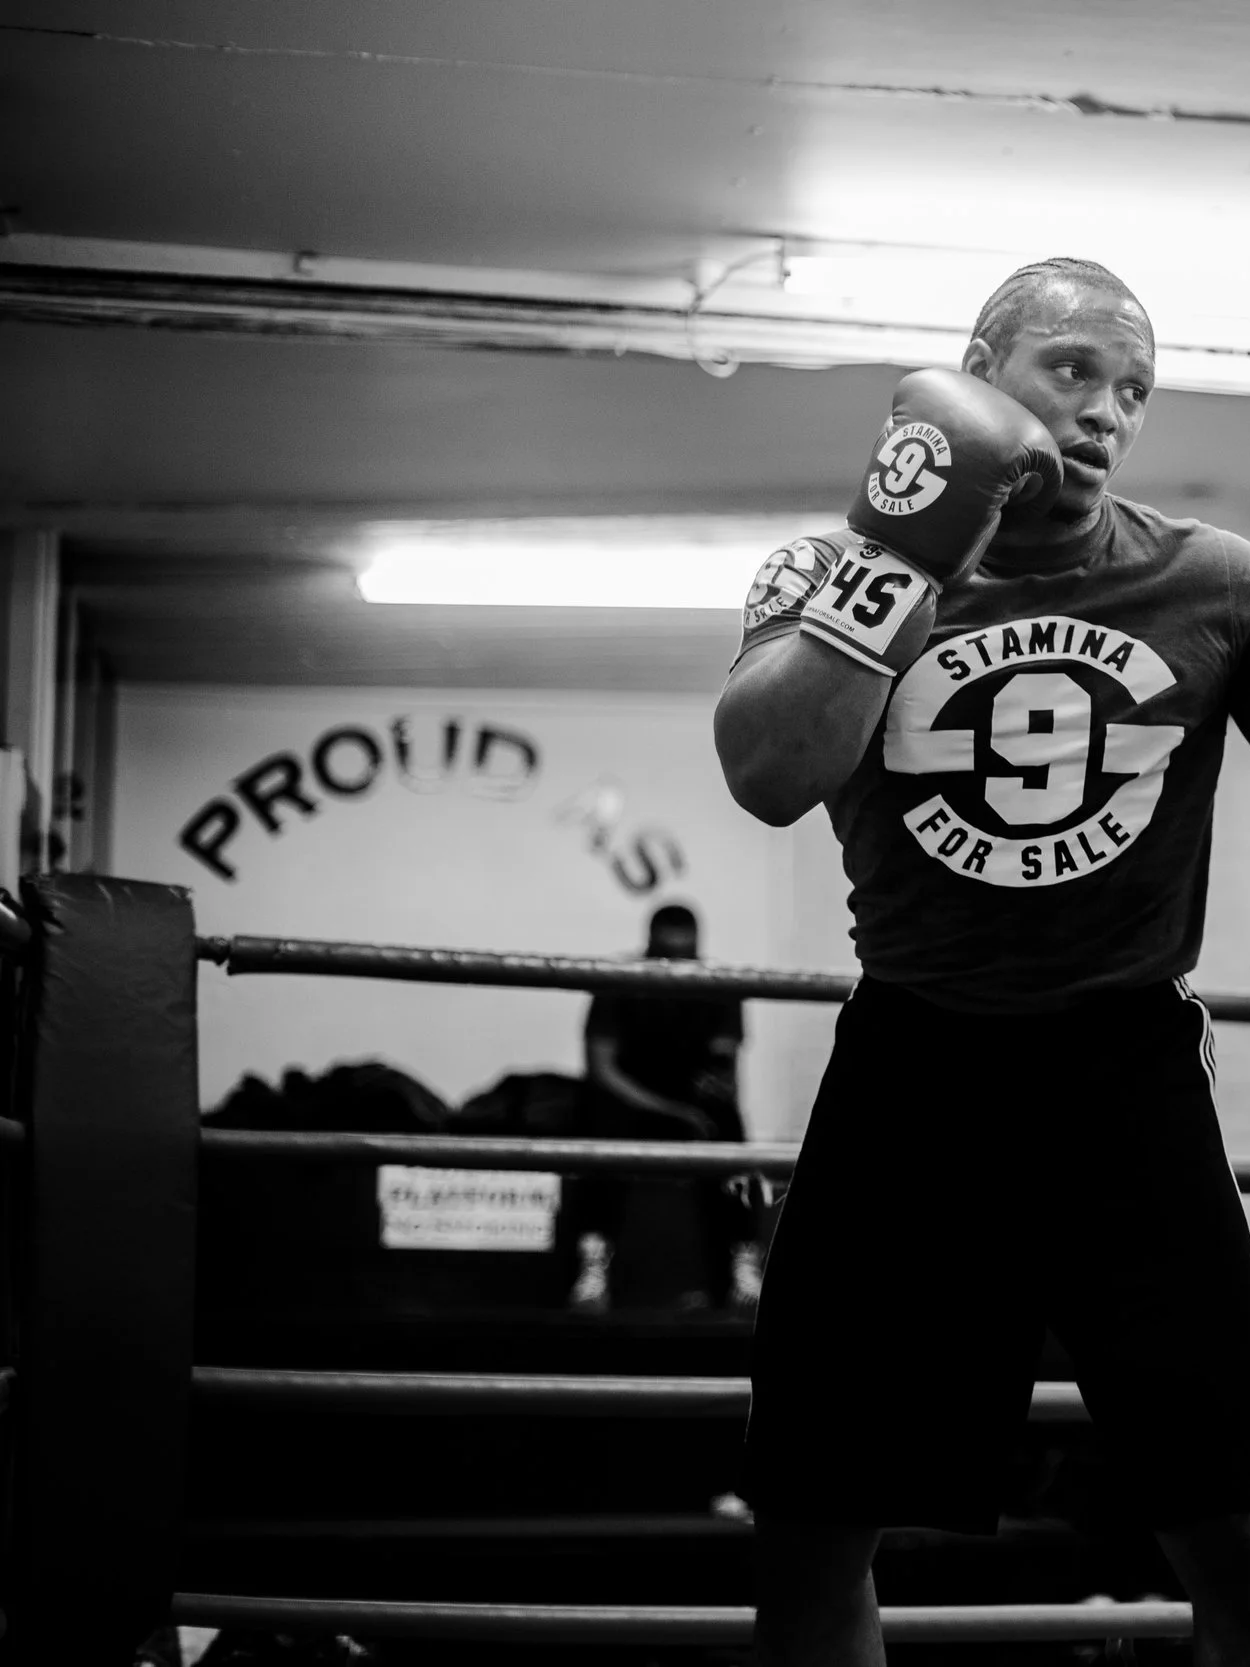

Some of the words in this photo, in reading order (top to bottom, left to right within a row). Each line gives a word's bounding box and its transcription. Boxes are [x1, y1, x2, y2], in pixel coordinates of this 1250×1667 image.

[902, 424, 948, 456] STAMINA
[869, 476, 880, 502] FOR
[880, 498, 915, 513] SALE
[937, 620, 1135, 681] STAMINA
[177, 714, 541, 885] PROUD
[915, 807, 993, 875] FOR
[1021, 811, 1131, 881] SALE
